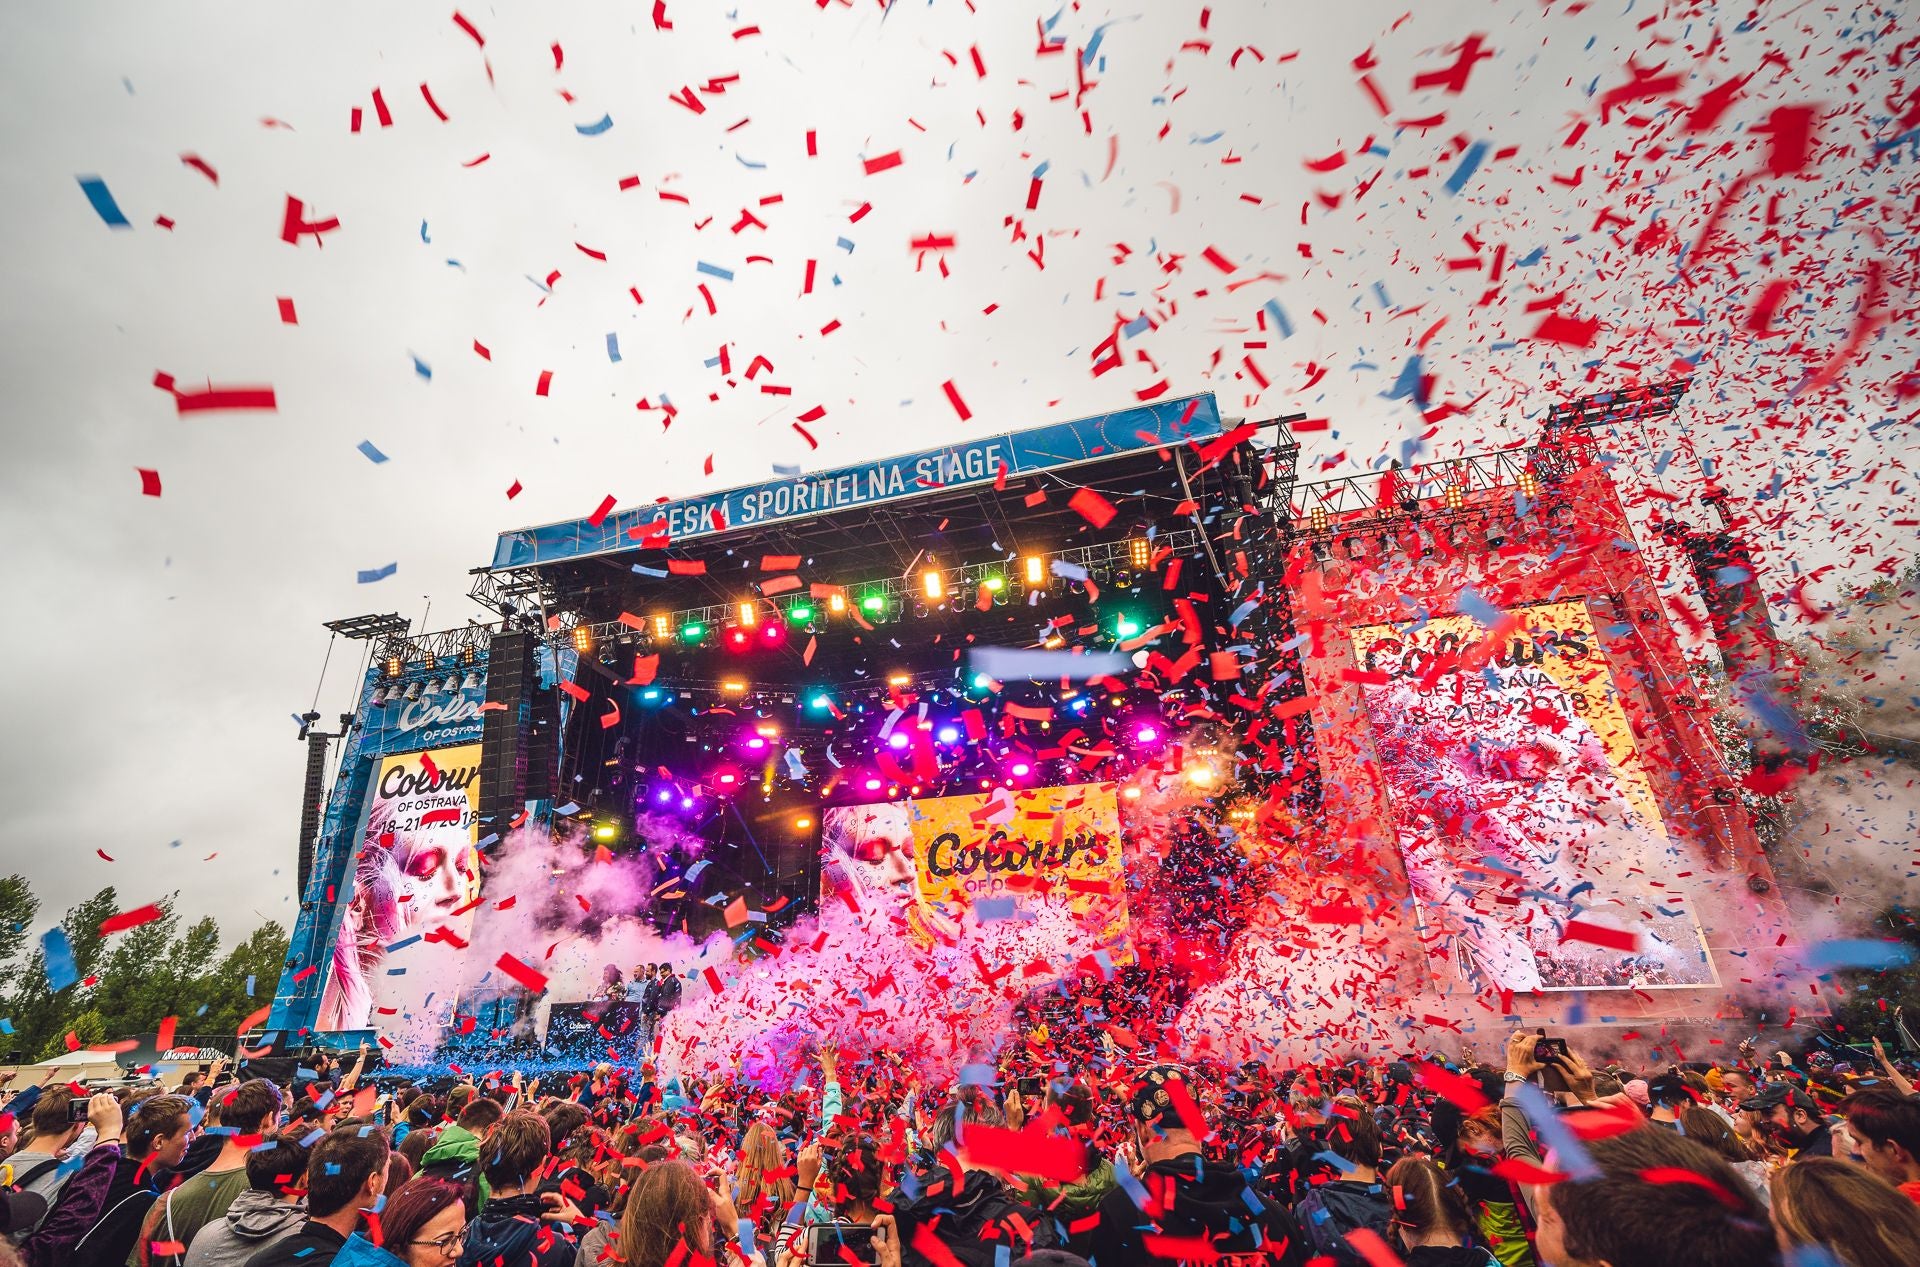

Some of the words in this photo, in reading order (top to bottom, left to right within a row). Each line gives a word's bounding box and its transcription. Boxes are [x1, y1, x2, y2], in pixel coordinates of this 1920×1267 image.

[741, 464, 905, 523] SPOŘITELNA
[916, 444, 1001, 488] STAGE
[423, 730, 441, 741] OF
[397, 802, 413, 812] OF
[414, 795, 467, 810] OSTRAVA
[965, 880, 987, 893] OF
